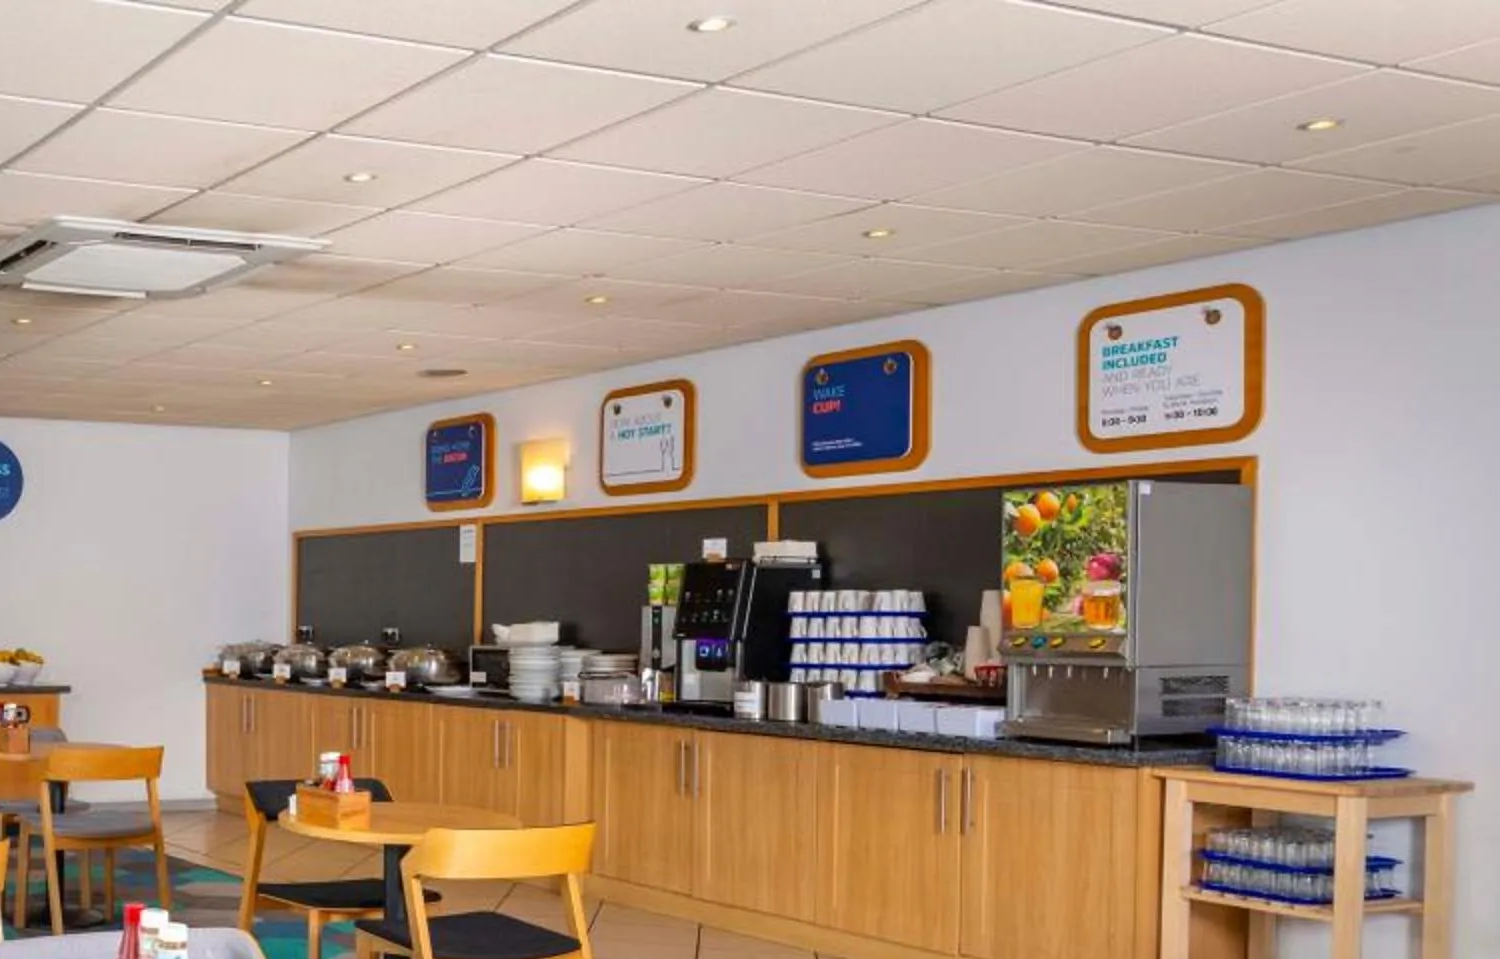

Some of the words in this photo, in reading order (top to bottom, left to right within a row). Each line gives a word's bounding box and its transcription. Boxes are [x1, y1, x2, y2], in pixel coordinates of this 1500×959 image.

[1102, 336, 1178, 357] BREAKFAST
[1102, 352, 1167, 370] INCLUDED
[617, 429, 635, 440] HOT
